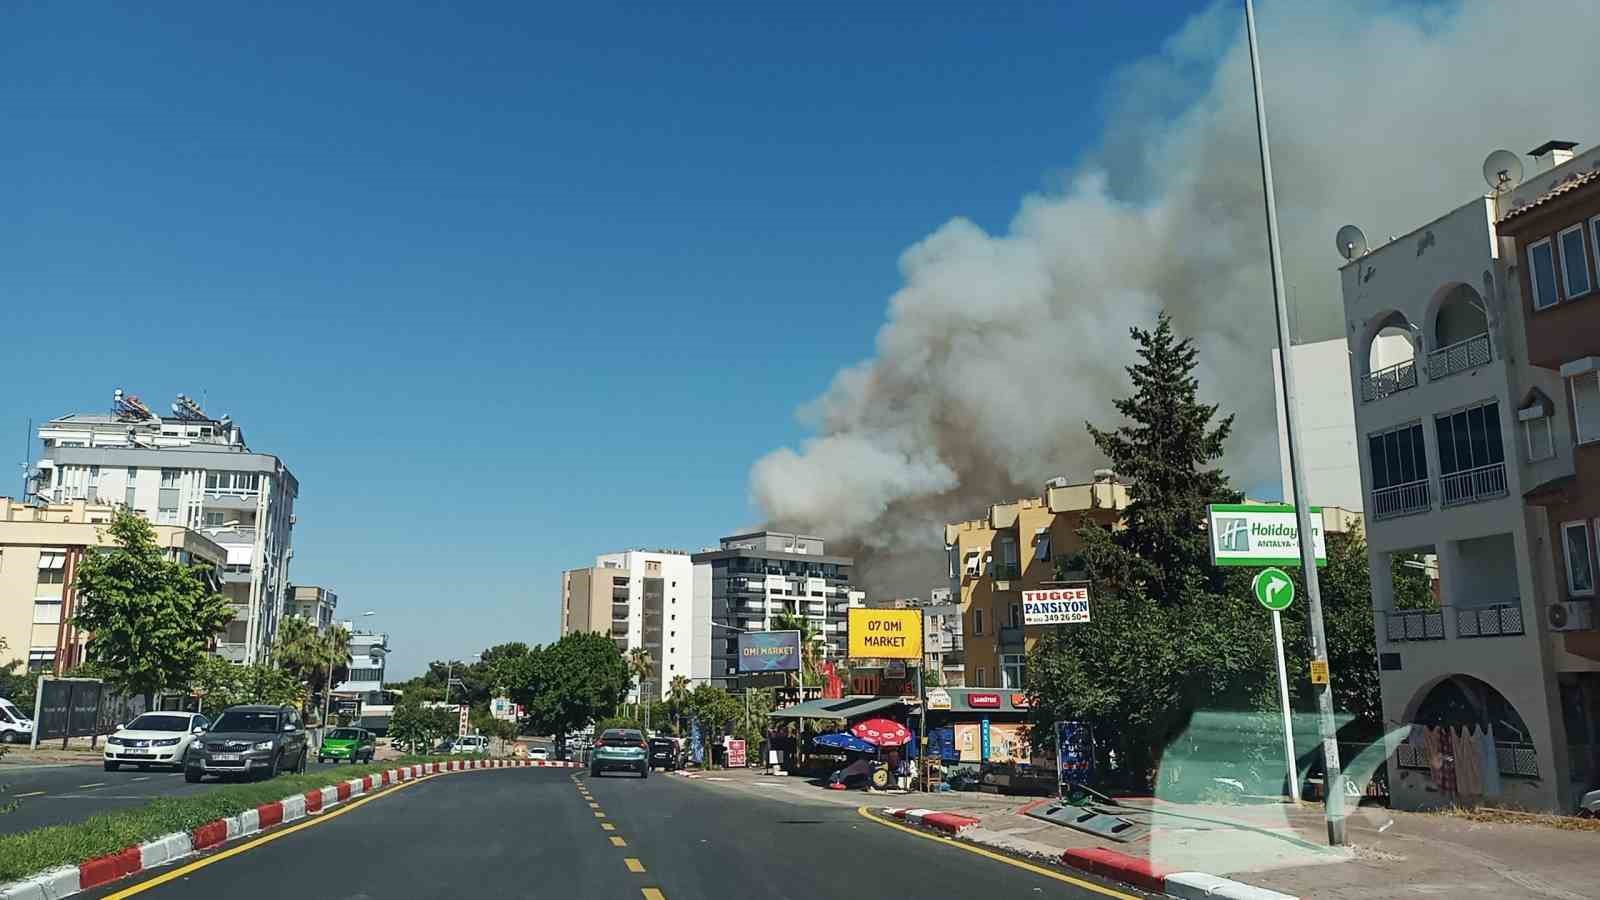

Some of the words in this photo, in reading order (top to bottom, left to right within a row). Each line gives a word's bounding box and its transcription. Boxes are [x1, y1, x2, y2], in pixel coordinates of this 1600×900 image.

[1252, 522, 1297, 538] Holiday
[868, 620, 881, 631] 07
[864, 636, 906, 647] MARKET
[760, 646, 794, 656] MARKET
